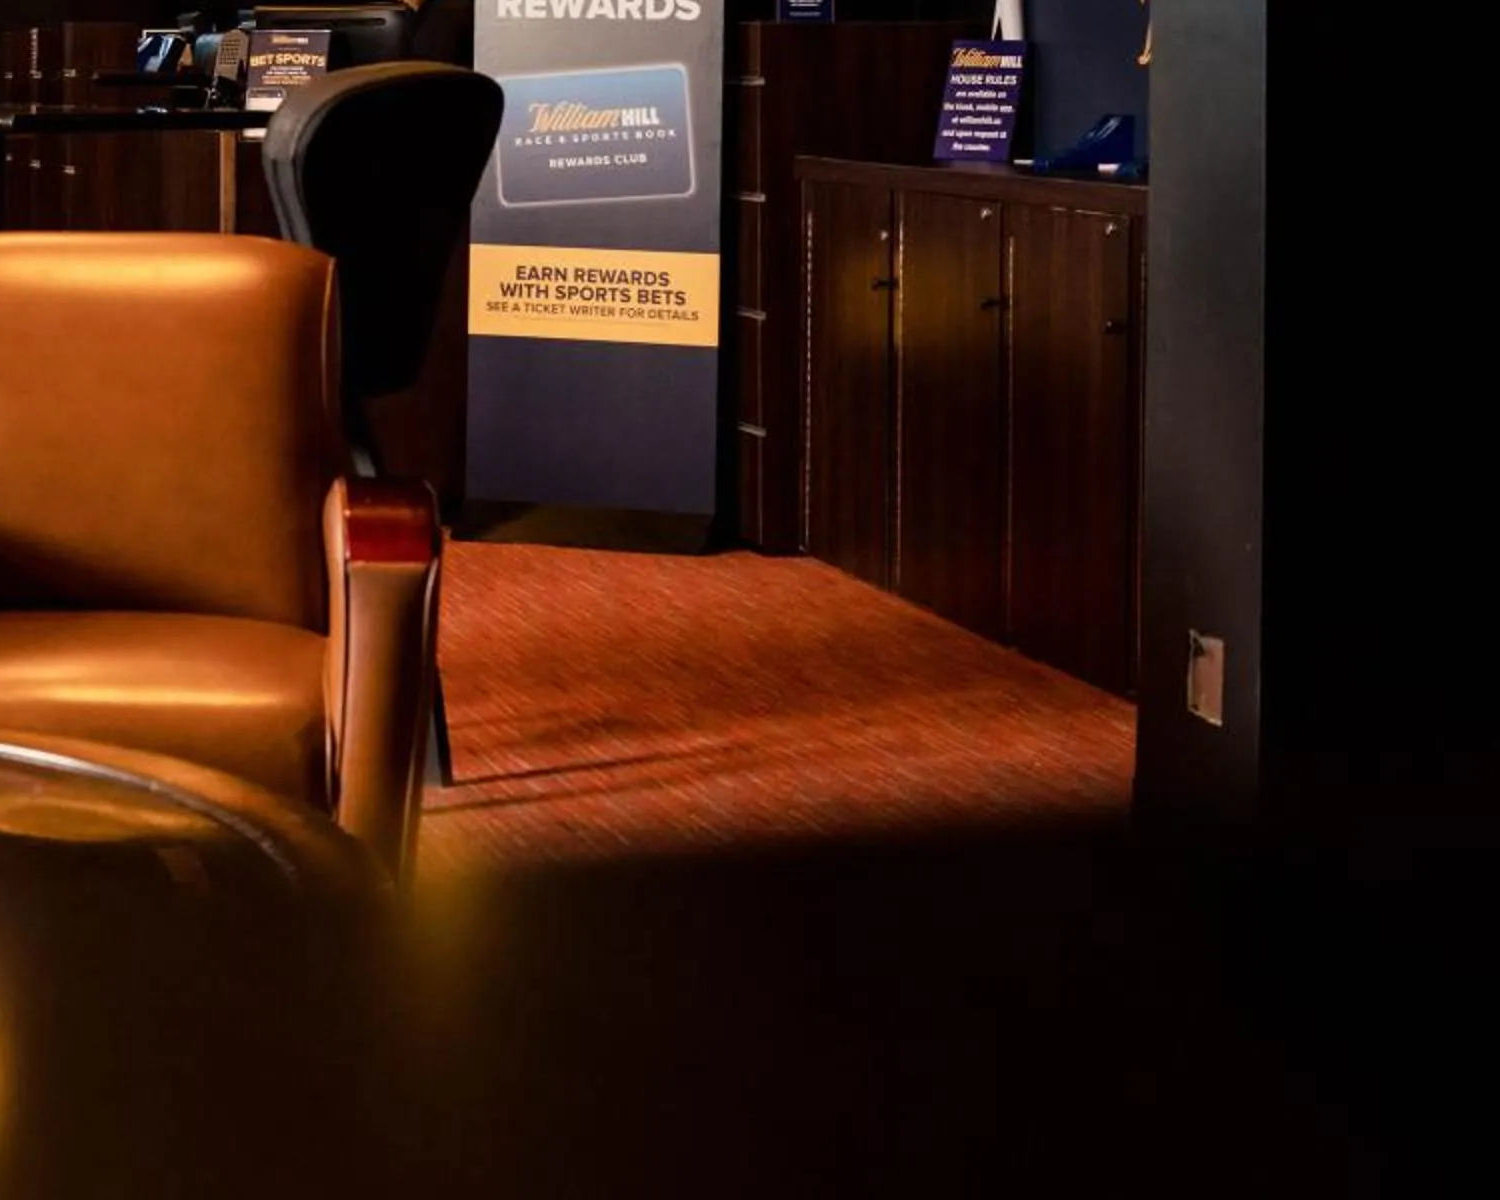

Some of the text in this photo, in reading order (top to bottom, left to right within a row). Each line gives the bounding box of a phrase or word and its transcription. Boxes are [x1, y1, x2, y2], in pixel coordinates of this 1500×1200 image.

[250, 53, 325, 68] BET SPORTS
[950, 75, 1017, 85] HOUSE RULES
[528, 100, 660, 133] William HILL
[514, 136, 552, 147] RACE
[572, 131, 629, 144] SPORTS
[635, 128, 676, 140] BOOK
[549, 152, 648, 169] REWARDS CLUB
[515, 265, 670, 287] EARN REWARDS
[500, 283, 687, 306] WITH SPORTS BETS
[486, 301, 700, 322] SEE A TICKET WRITER FOR DETAILS
